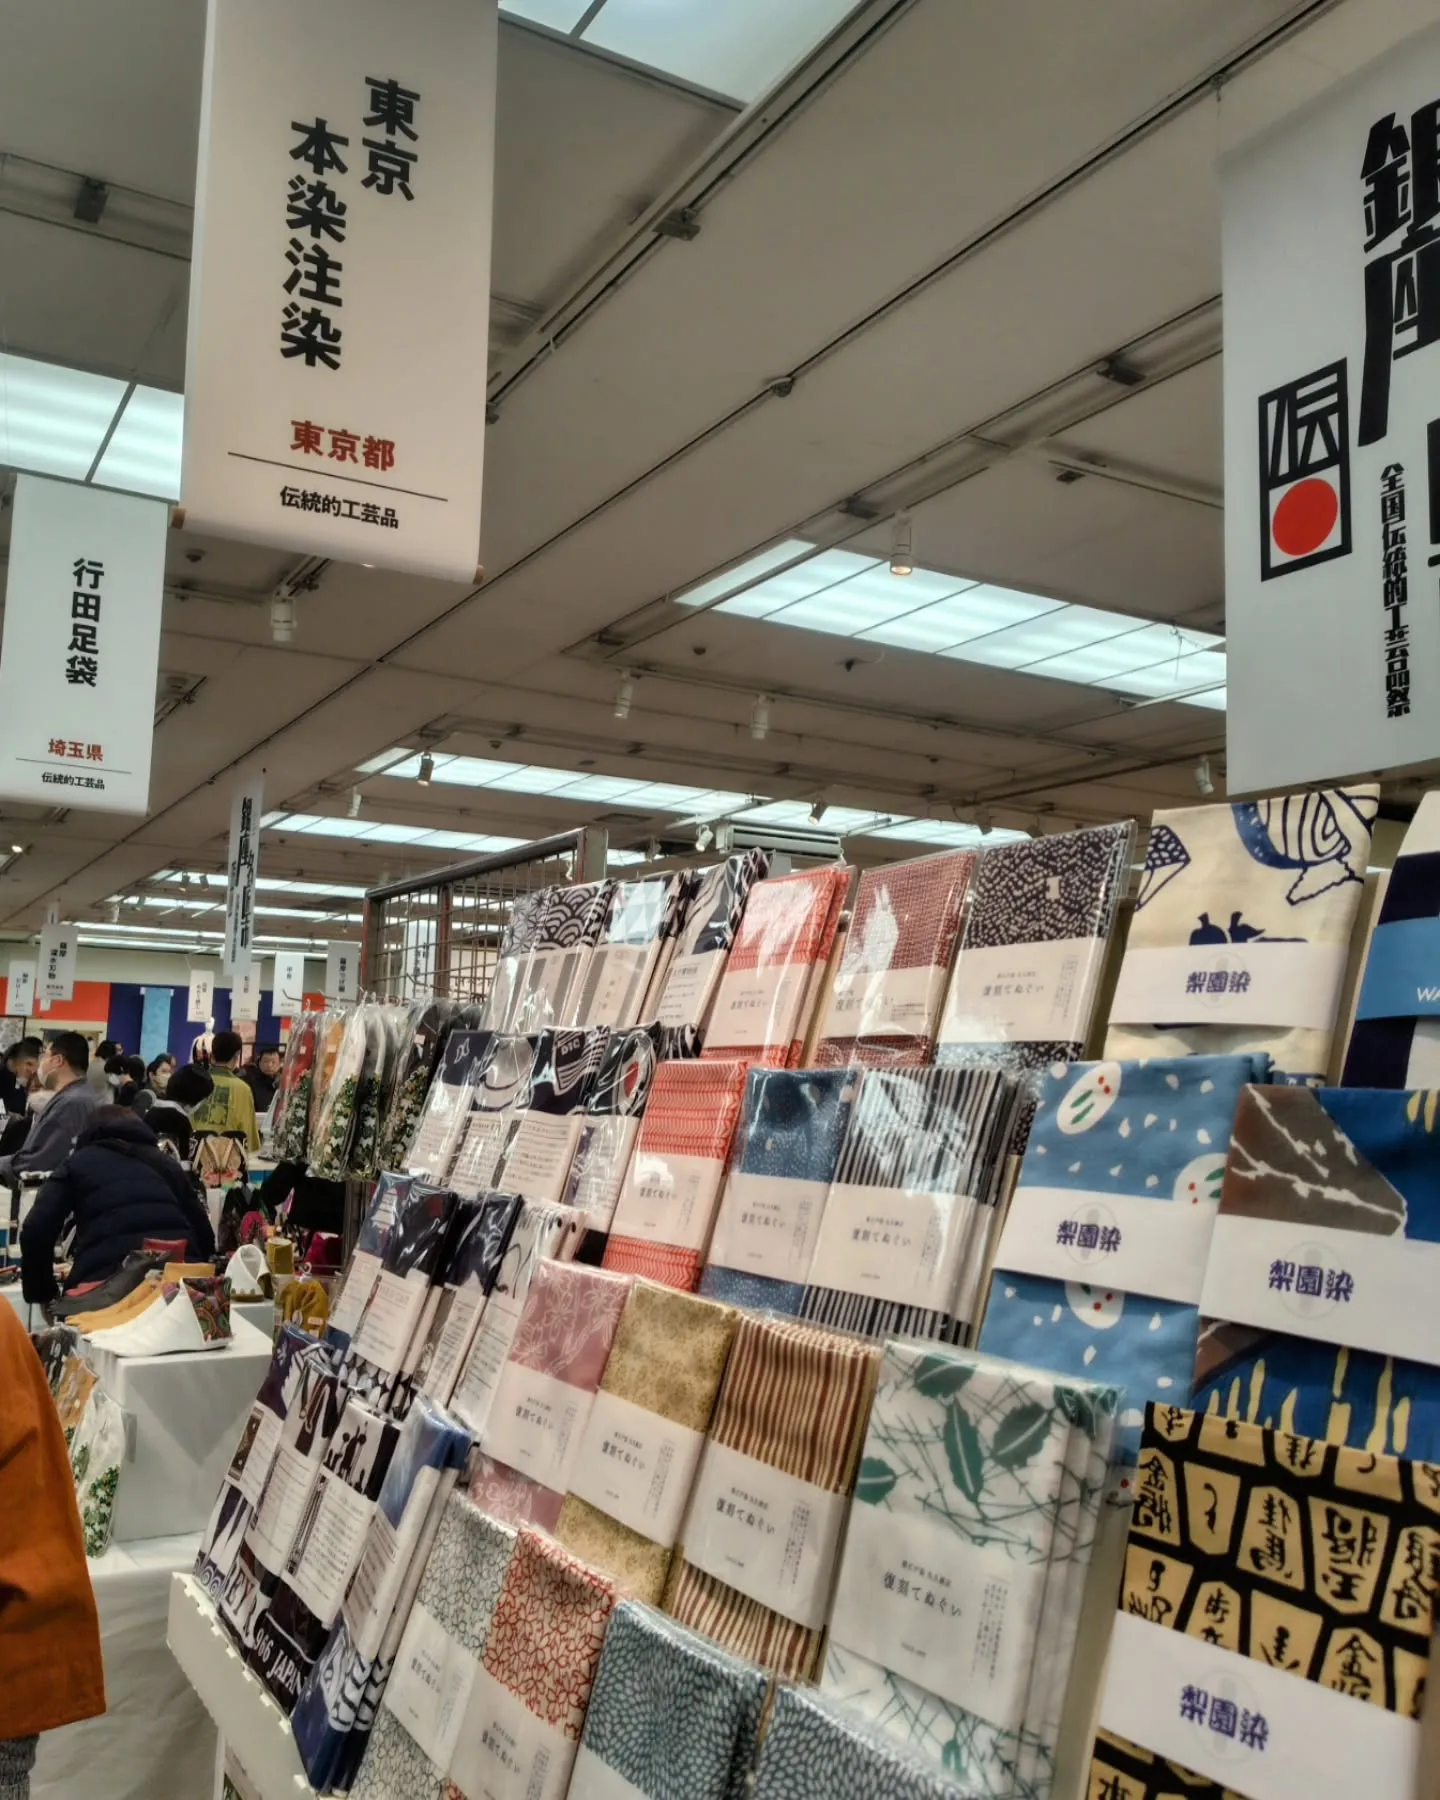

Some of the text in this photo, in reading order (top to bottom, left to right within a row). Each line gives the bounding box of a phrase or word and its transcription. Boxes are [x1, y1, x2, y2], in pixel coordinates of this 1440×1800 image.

[362, 76, 420, 201] 東京
[280, 117, 349, 370] 本染注染
[290, 420, 395, 471] 東京都
[280, 486, 399, 529] 伝統的工芸品
[66, 558, 104, 687] 行田足袋
[48, 738, 104, 762] 埼玉県
[41, 772, 105, 789] 伝統的工芸品
[1185, 970, 1251, 994] 梨園染
[1056, 1219, 1122, 1252] 梨園染
[1268, 1259, 1355, 1302] 梨園染
[1180, 1684, 1270, 1752] 梨園染
